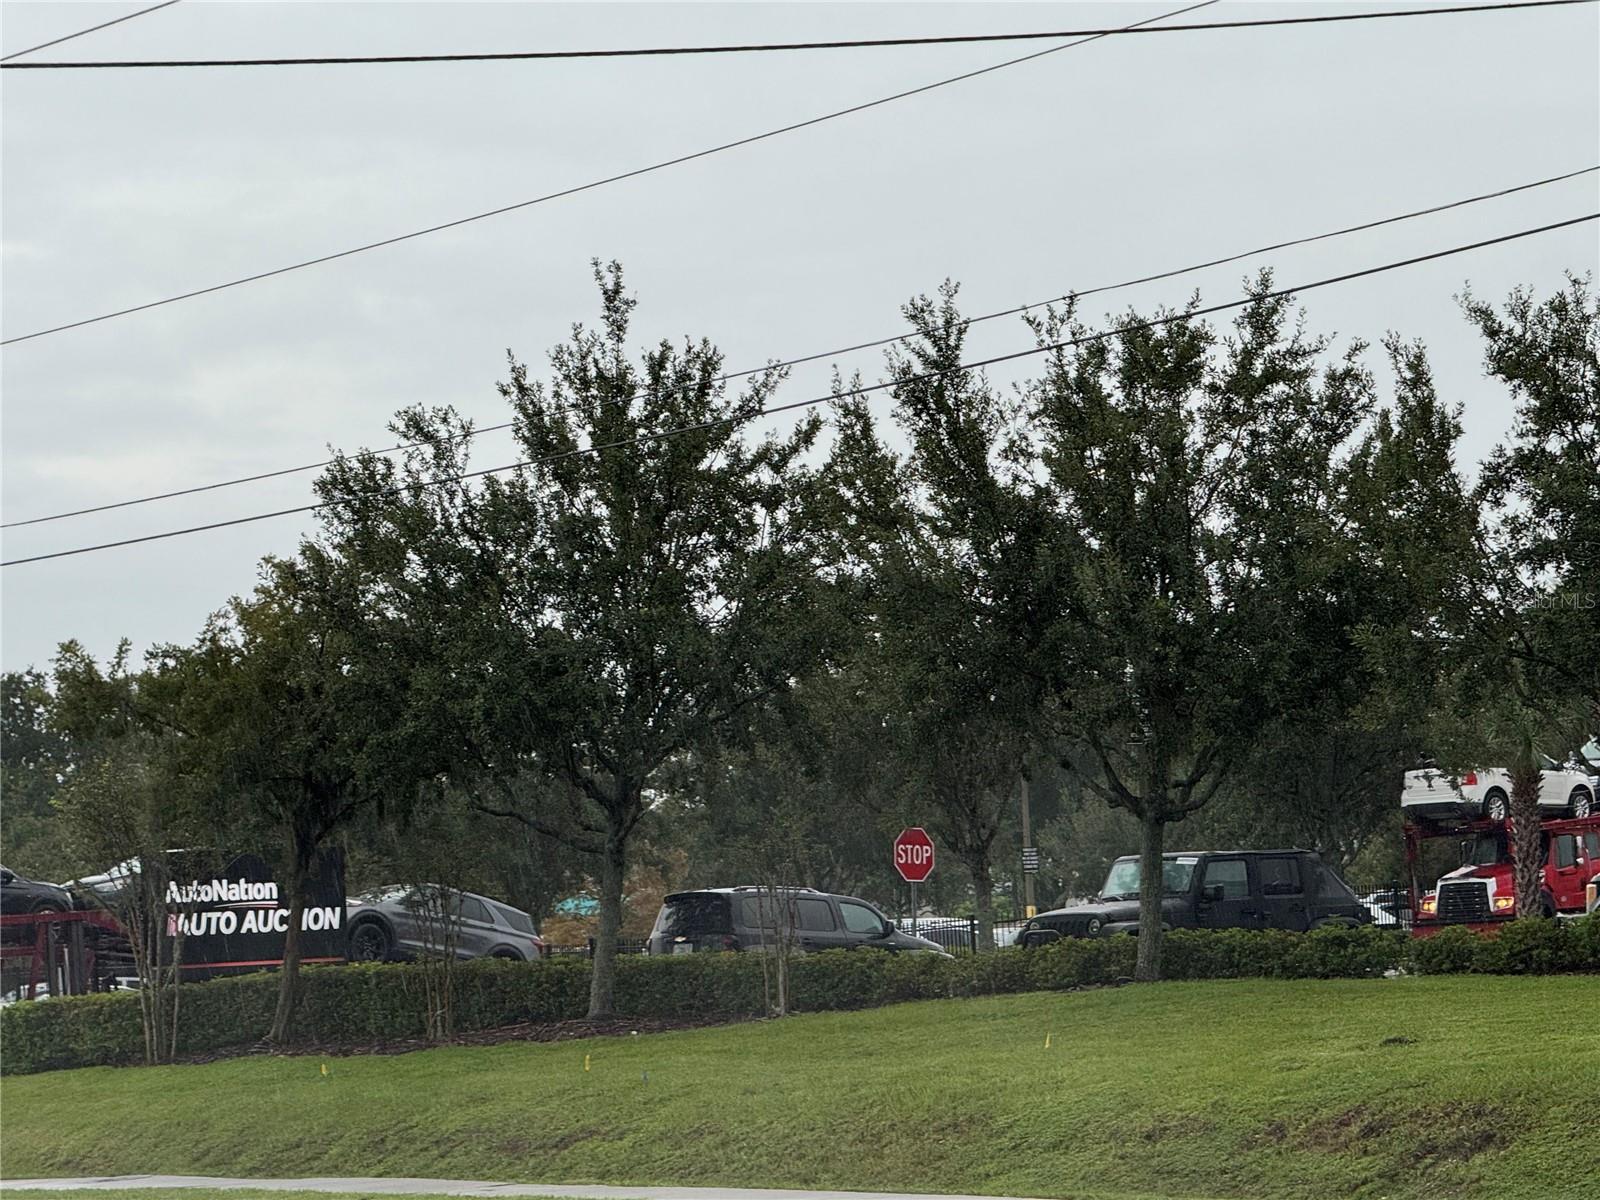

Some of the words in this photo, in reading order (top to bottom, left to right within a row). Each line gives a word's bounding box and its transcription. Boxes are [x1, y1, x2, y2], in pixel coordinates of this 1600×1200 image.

[898, 845, 931, 864] STOP
[165, 878, 278, 903] AutoNation
[240, 907, 341, 934] AUCION
